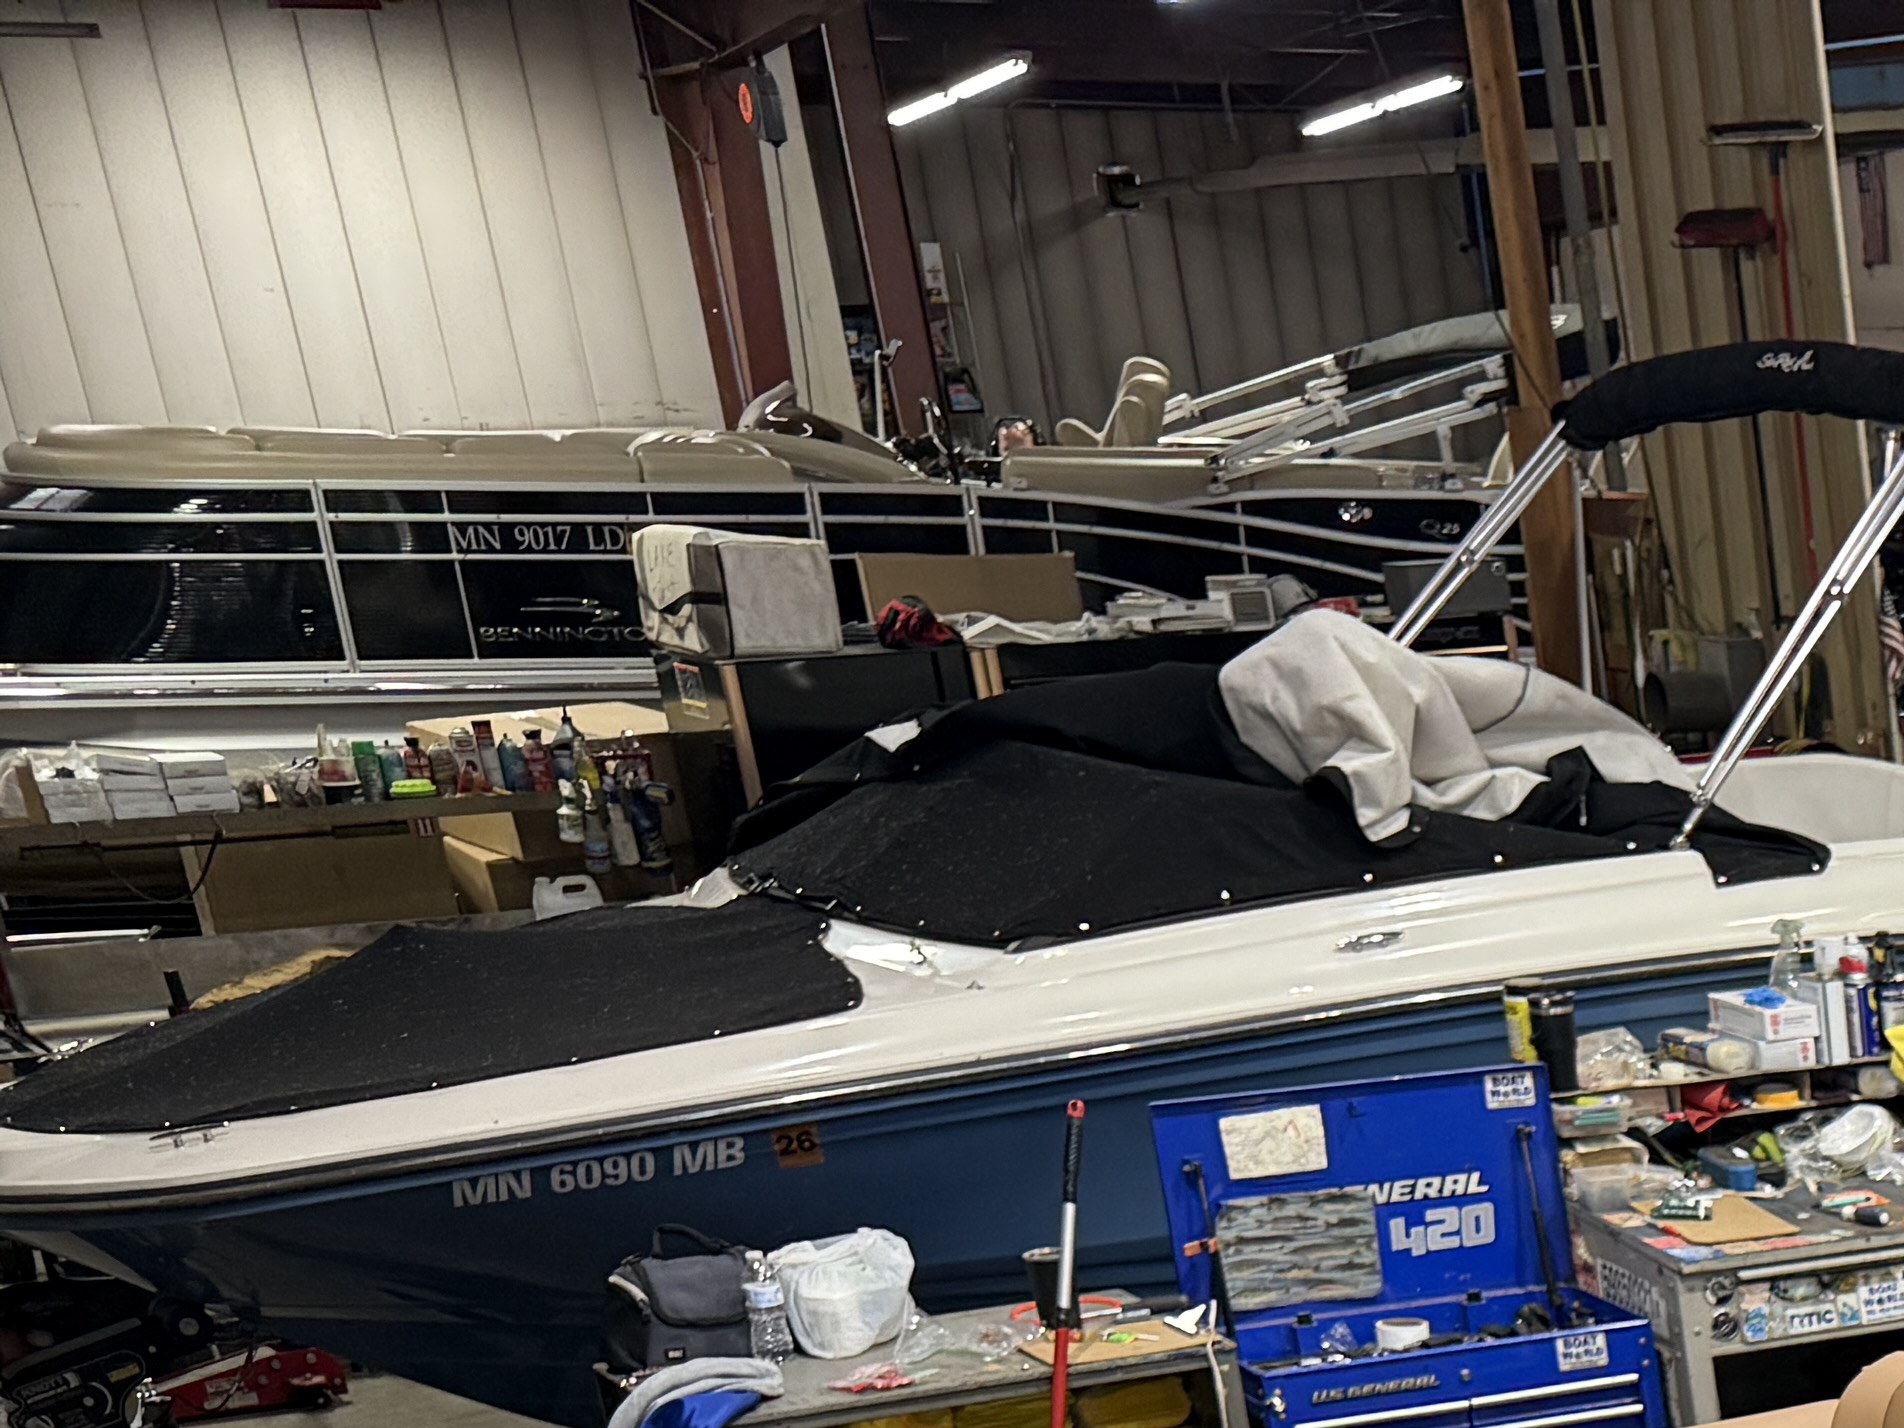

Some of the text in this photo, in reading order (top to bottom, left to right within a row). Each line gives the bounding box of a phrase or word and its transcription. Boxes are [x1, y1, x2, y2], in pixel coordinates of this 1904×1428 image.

[451, 525, 626, 550] MN 9017 LD
[479, 626, 647, 642] BENNINGTO
[774, 1130, 817, 1157] 26
[452, 1136, 745, 1207] MN 6090 MB
[1318, 1170, 1490, 1205] NERAL
[1389, 1202, 1496, 1257] 420
[1347, 1374, 1440, 1398] GENERAL
